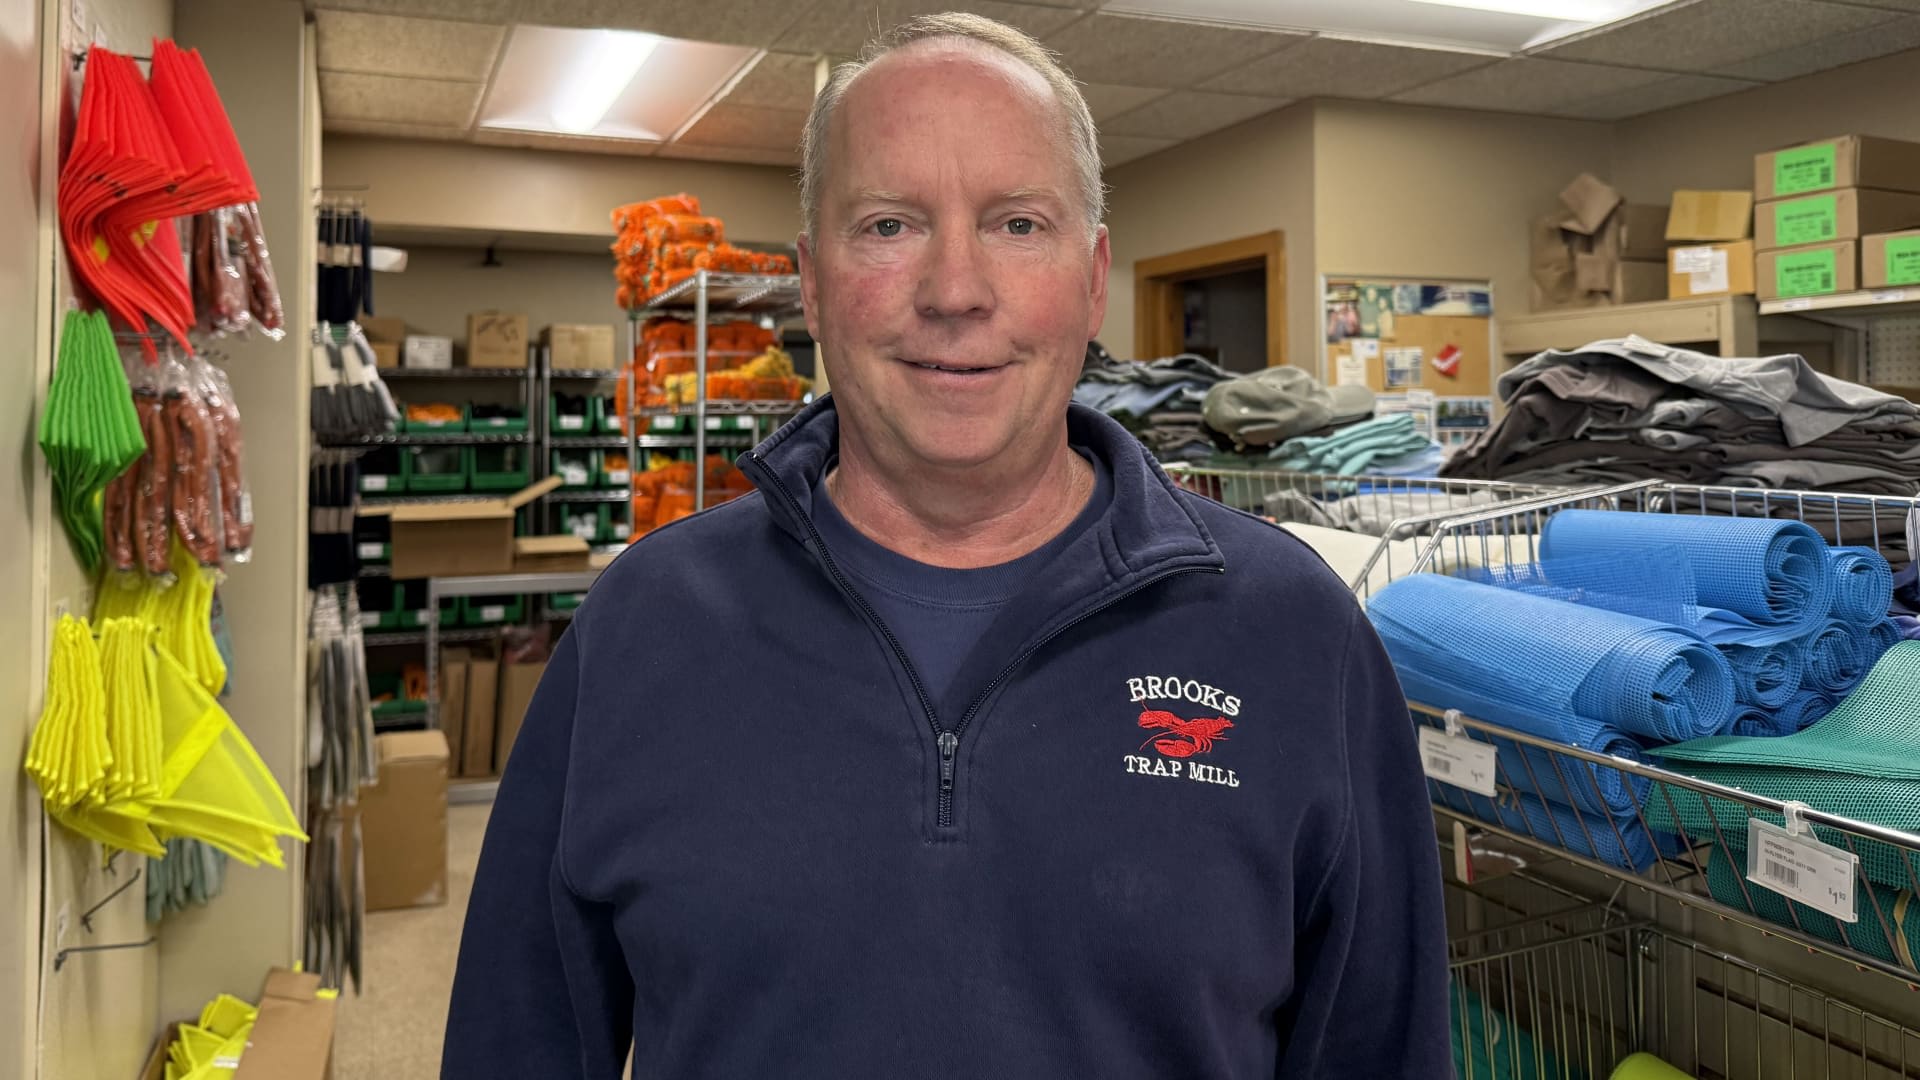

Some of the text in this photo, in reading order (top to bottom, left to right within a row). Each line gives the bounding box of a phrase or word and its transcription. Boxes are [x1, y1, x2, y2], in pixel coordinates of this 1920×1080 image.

[1126, 675, 1241, 716] BROOKS
[1123, 755, 1240, 788] TRAP MILL
